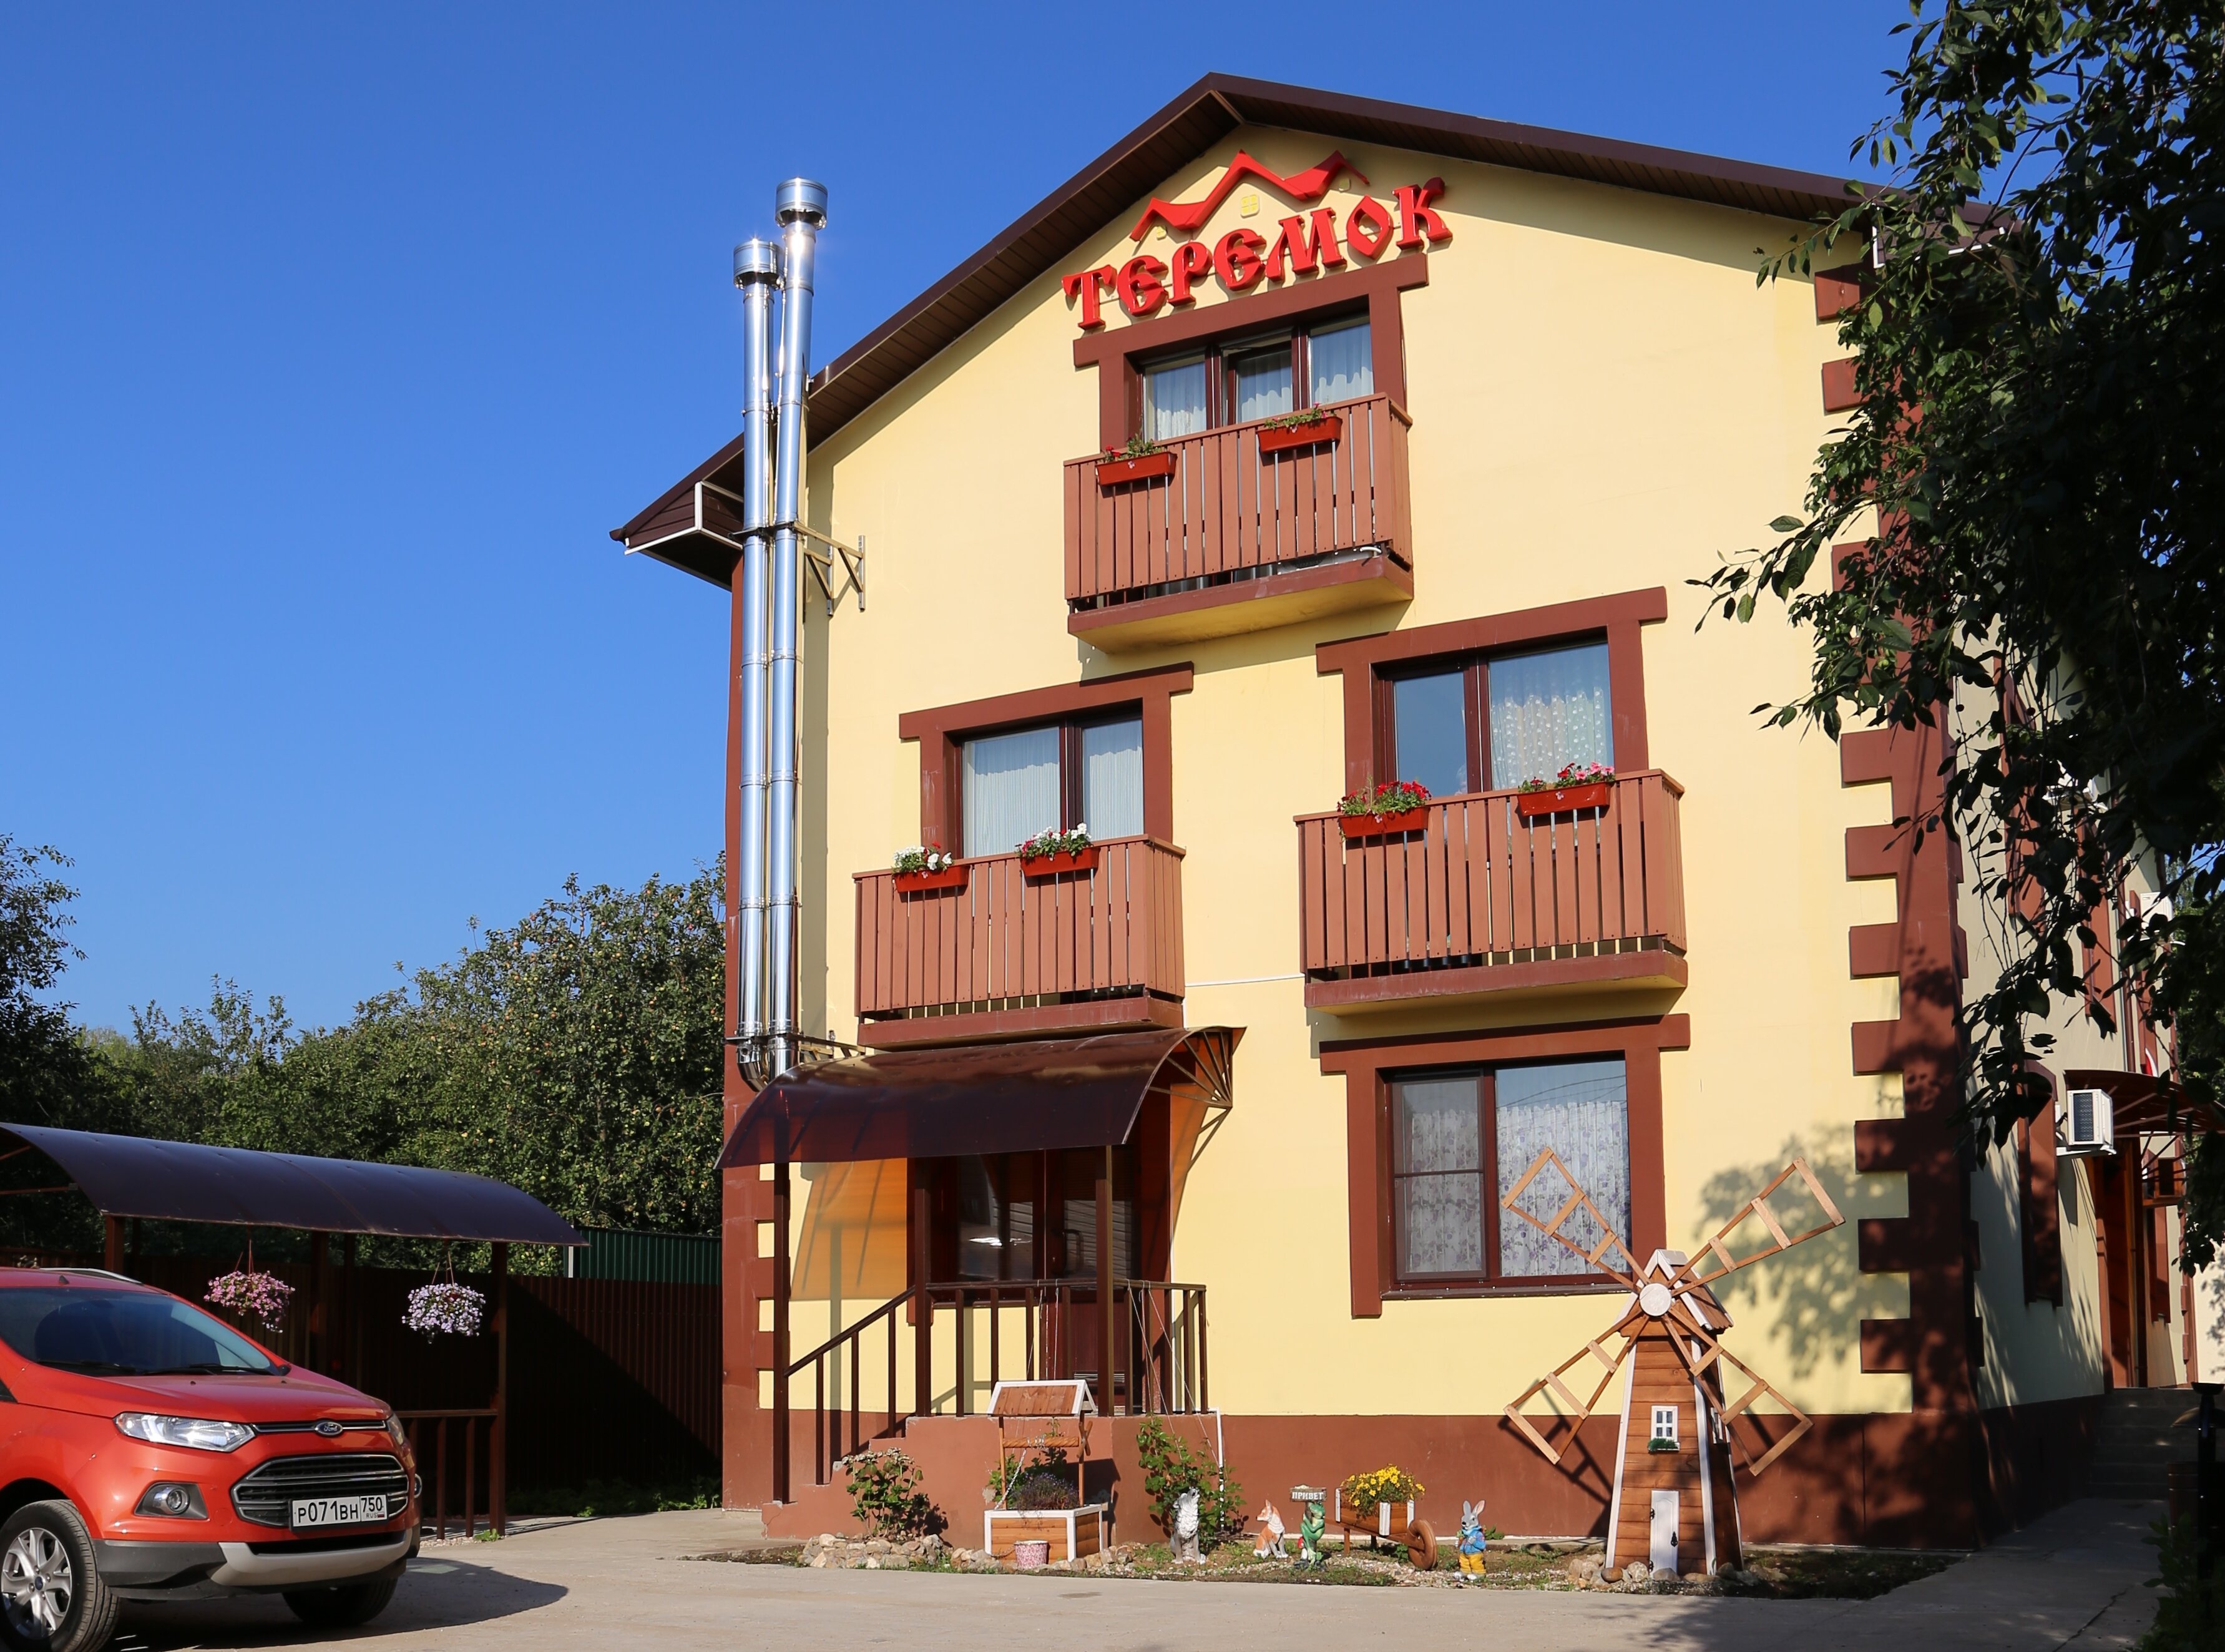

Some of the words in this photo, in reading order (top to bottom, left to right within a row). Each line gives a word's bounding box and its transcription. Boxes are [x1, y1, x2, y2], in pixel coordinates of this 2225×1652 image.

[1062, 176, 1454, 330] ТЕРЕМОК
[1291, 1491, 1324, 1500] ПРИВЕТ
[361, 1497, 383, 1512] 750
